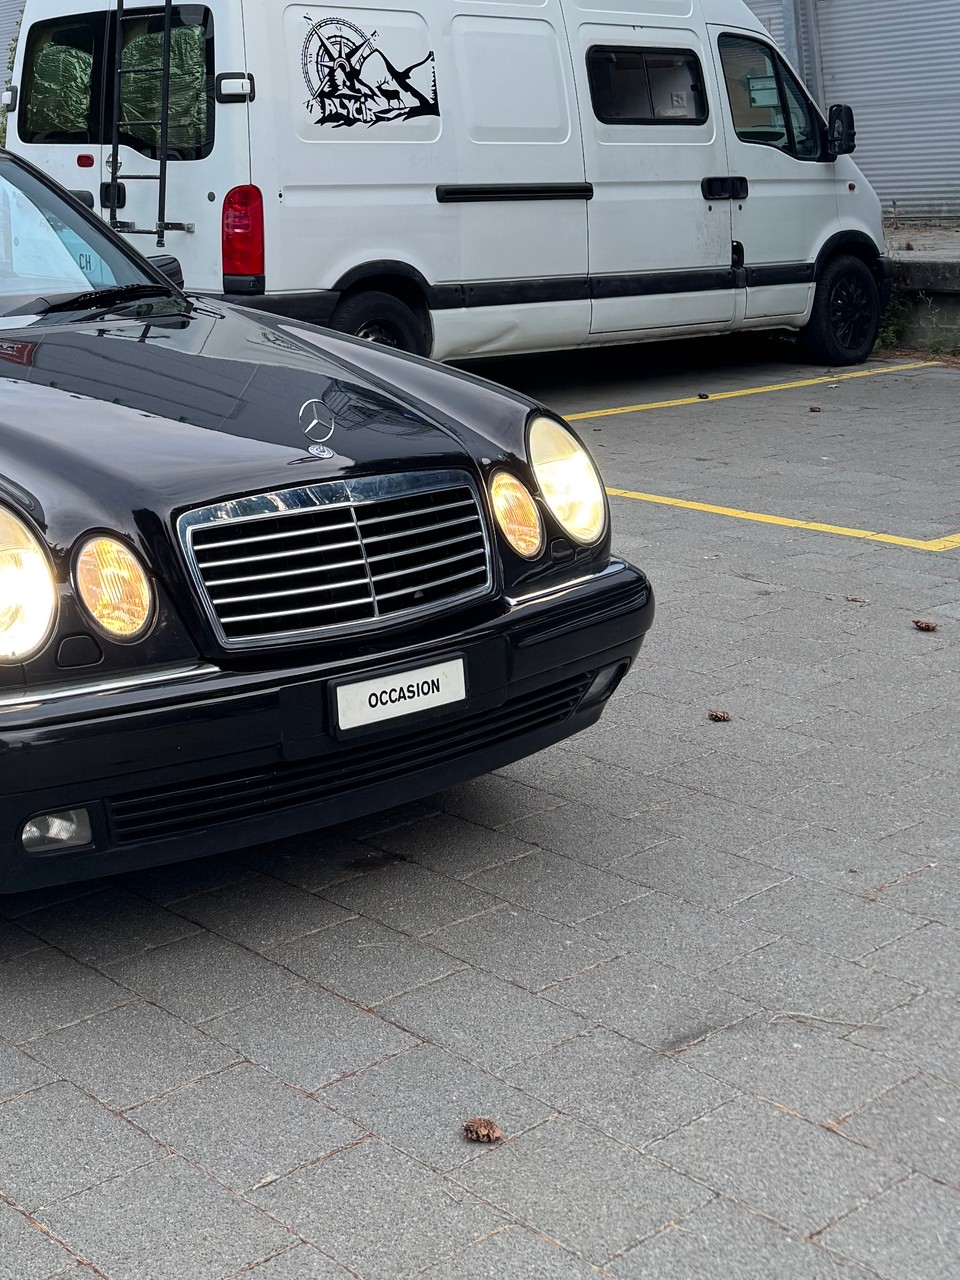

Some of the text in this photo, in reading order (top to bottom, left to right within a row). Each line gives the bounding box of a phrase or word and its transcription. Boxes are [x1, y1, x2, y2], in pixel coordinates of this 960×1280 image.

[323, 95, 377, 123] ALYCIA
[79, 253, 92, 272] CH
[368, 678, 441, 709] OCCASION
